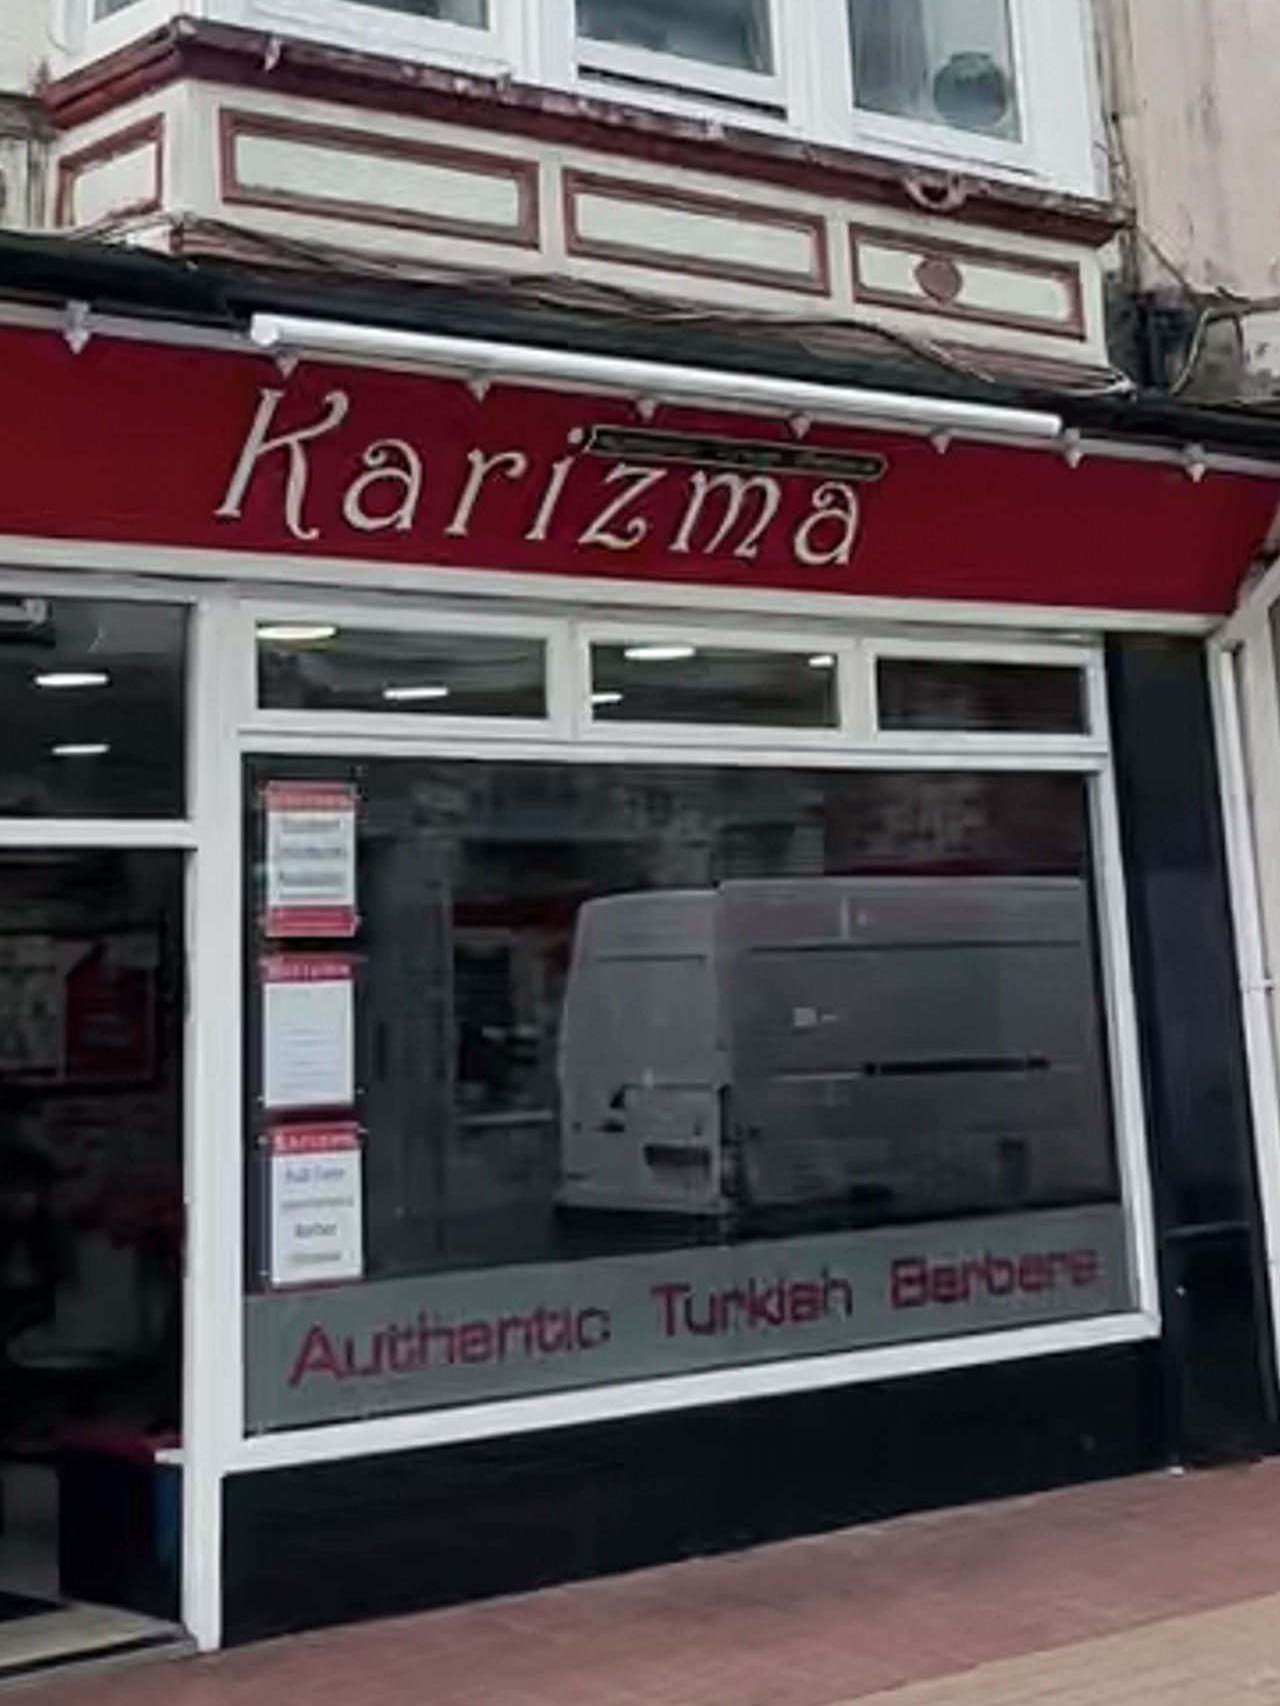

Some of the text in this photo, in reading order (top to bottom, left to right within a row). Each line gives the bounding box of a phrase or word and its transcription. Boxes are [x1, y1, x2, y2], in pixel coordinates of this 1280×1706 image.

[213, 389, 861, 567] Karizma
[287, 1248, 1101, 1387] Authentic Turkish Barbers
